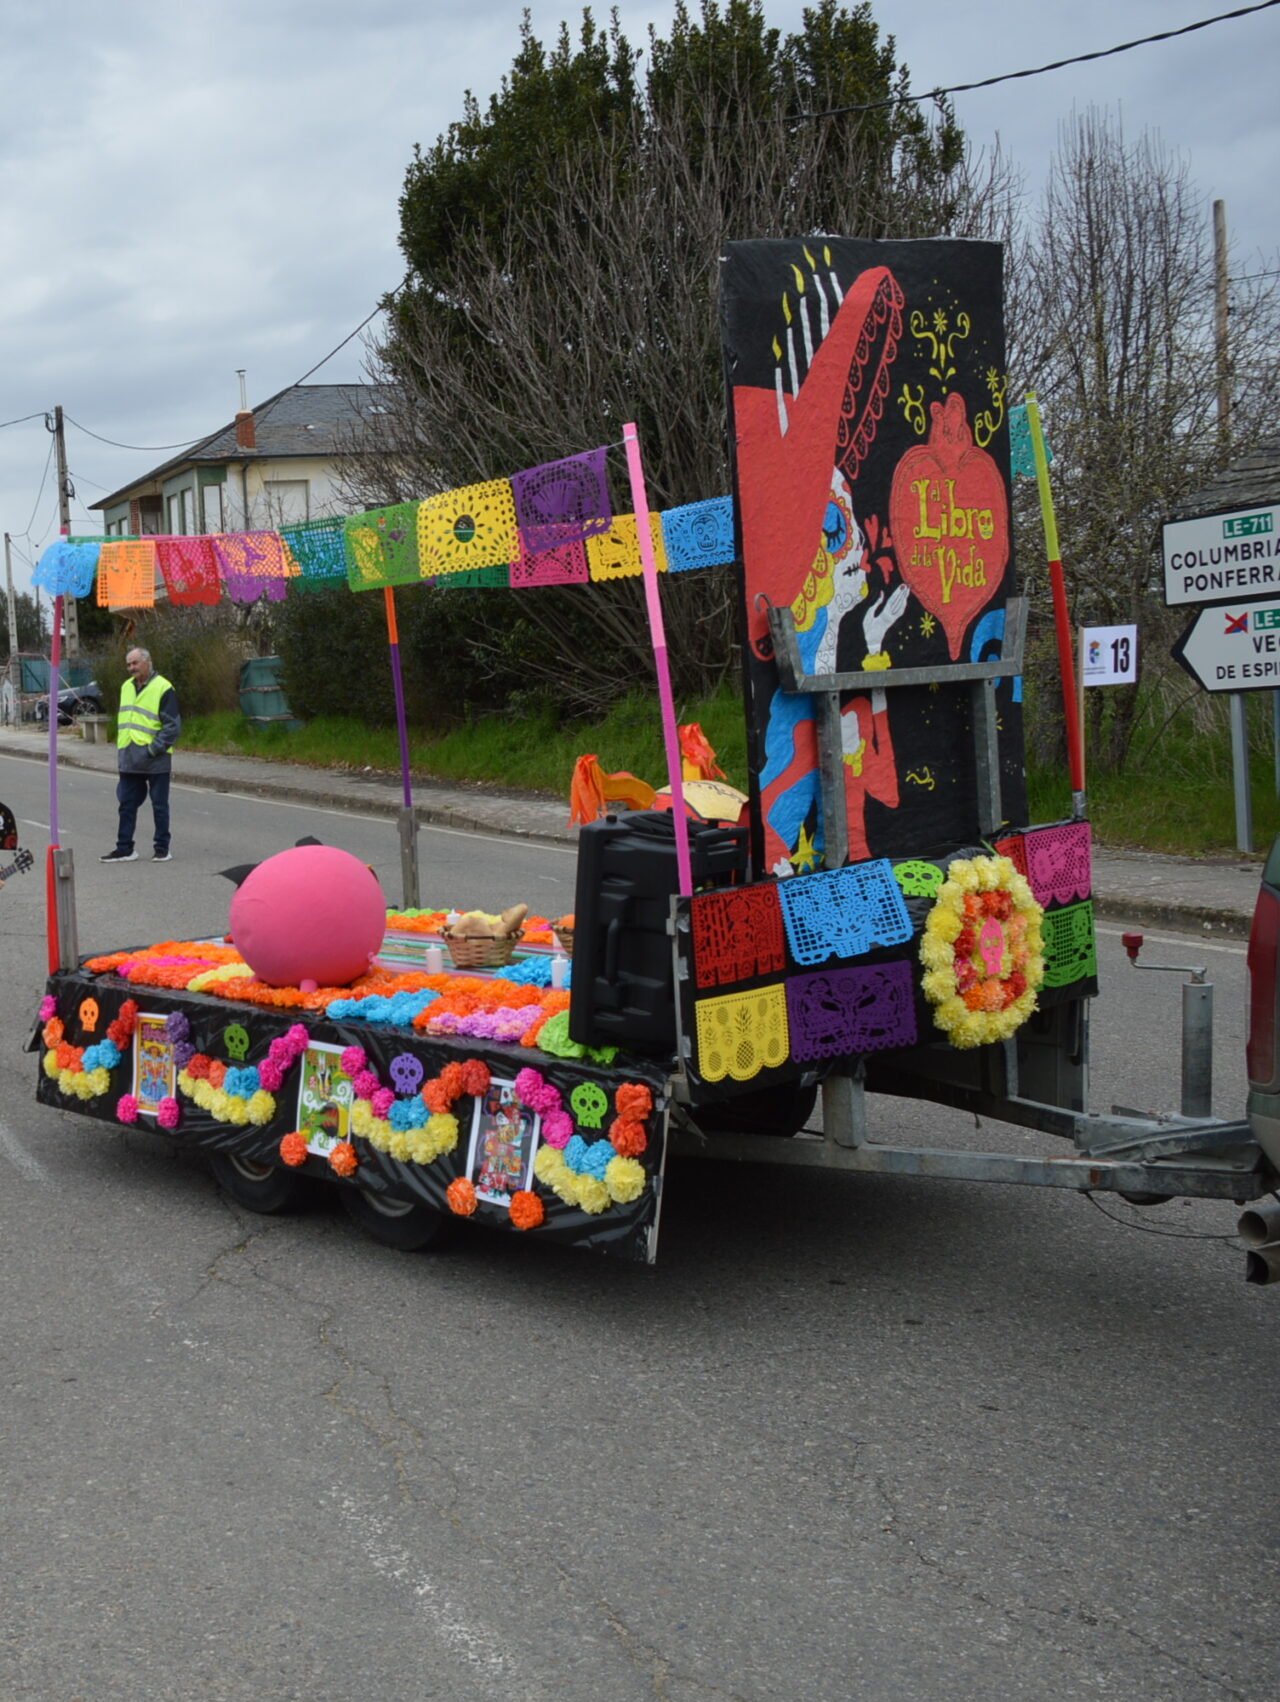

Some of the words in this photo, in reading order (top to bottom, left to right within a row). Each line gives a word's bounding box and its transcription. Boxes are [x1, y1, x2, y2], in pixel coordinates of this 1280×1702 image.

[931, 481, 941, 502] el
[911, 479, 994, 542] Libro
[1224, 515, 1272, 537] LE-711
[923, 544, 932, 567] la
[933, 545, 986, 604] Vida
[1184, 565, 1280, 592] PONFERR
[1111, 637, 1130, 673] 13
[1253, 635, 1280, 654] VE
[1216, 665, 1236, 680] DE
[1242, 661, 1280, 678] ESPI
